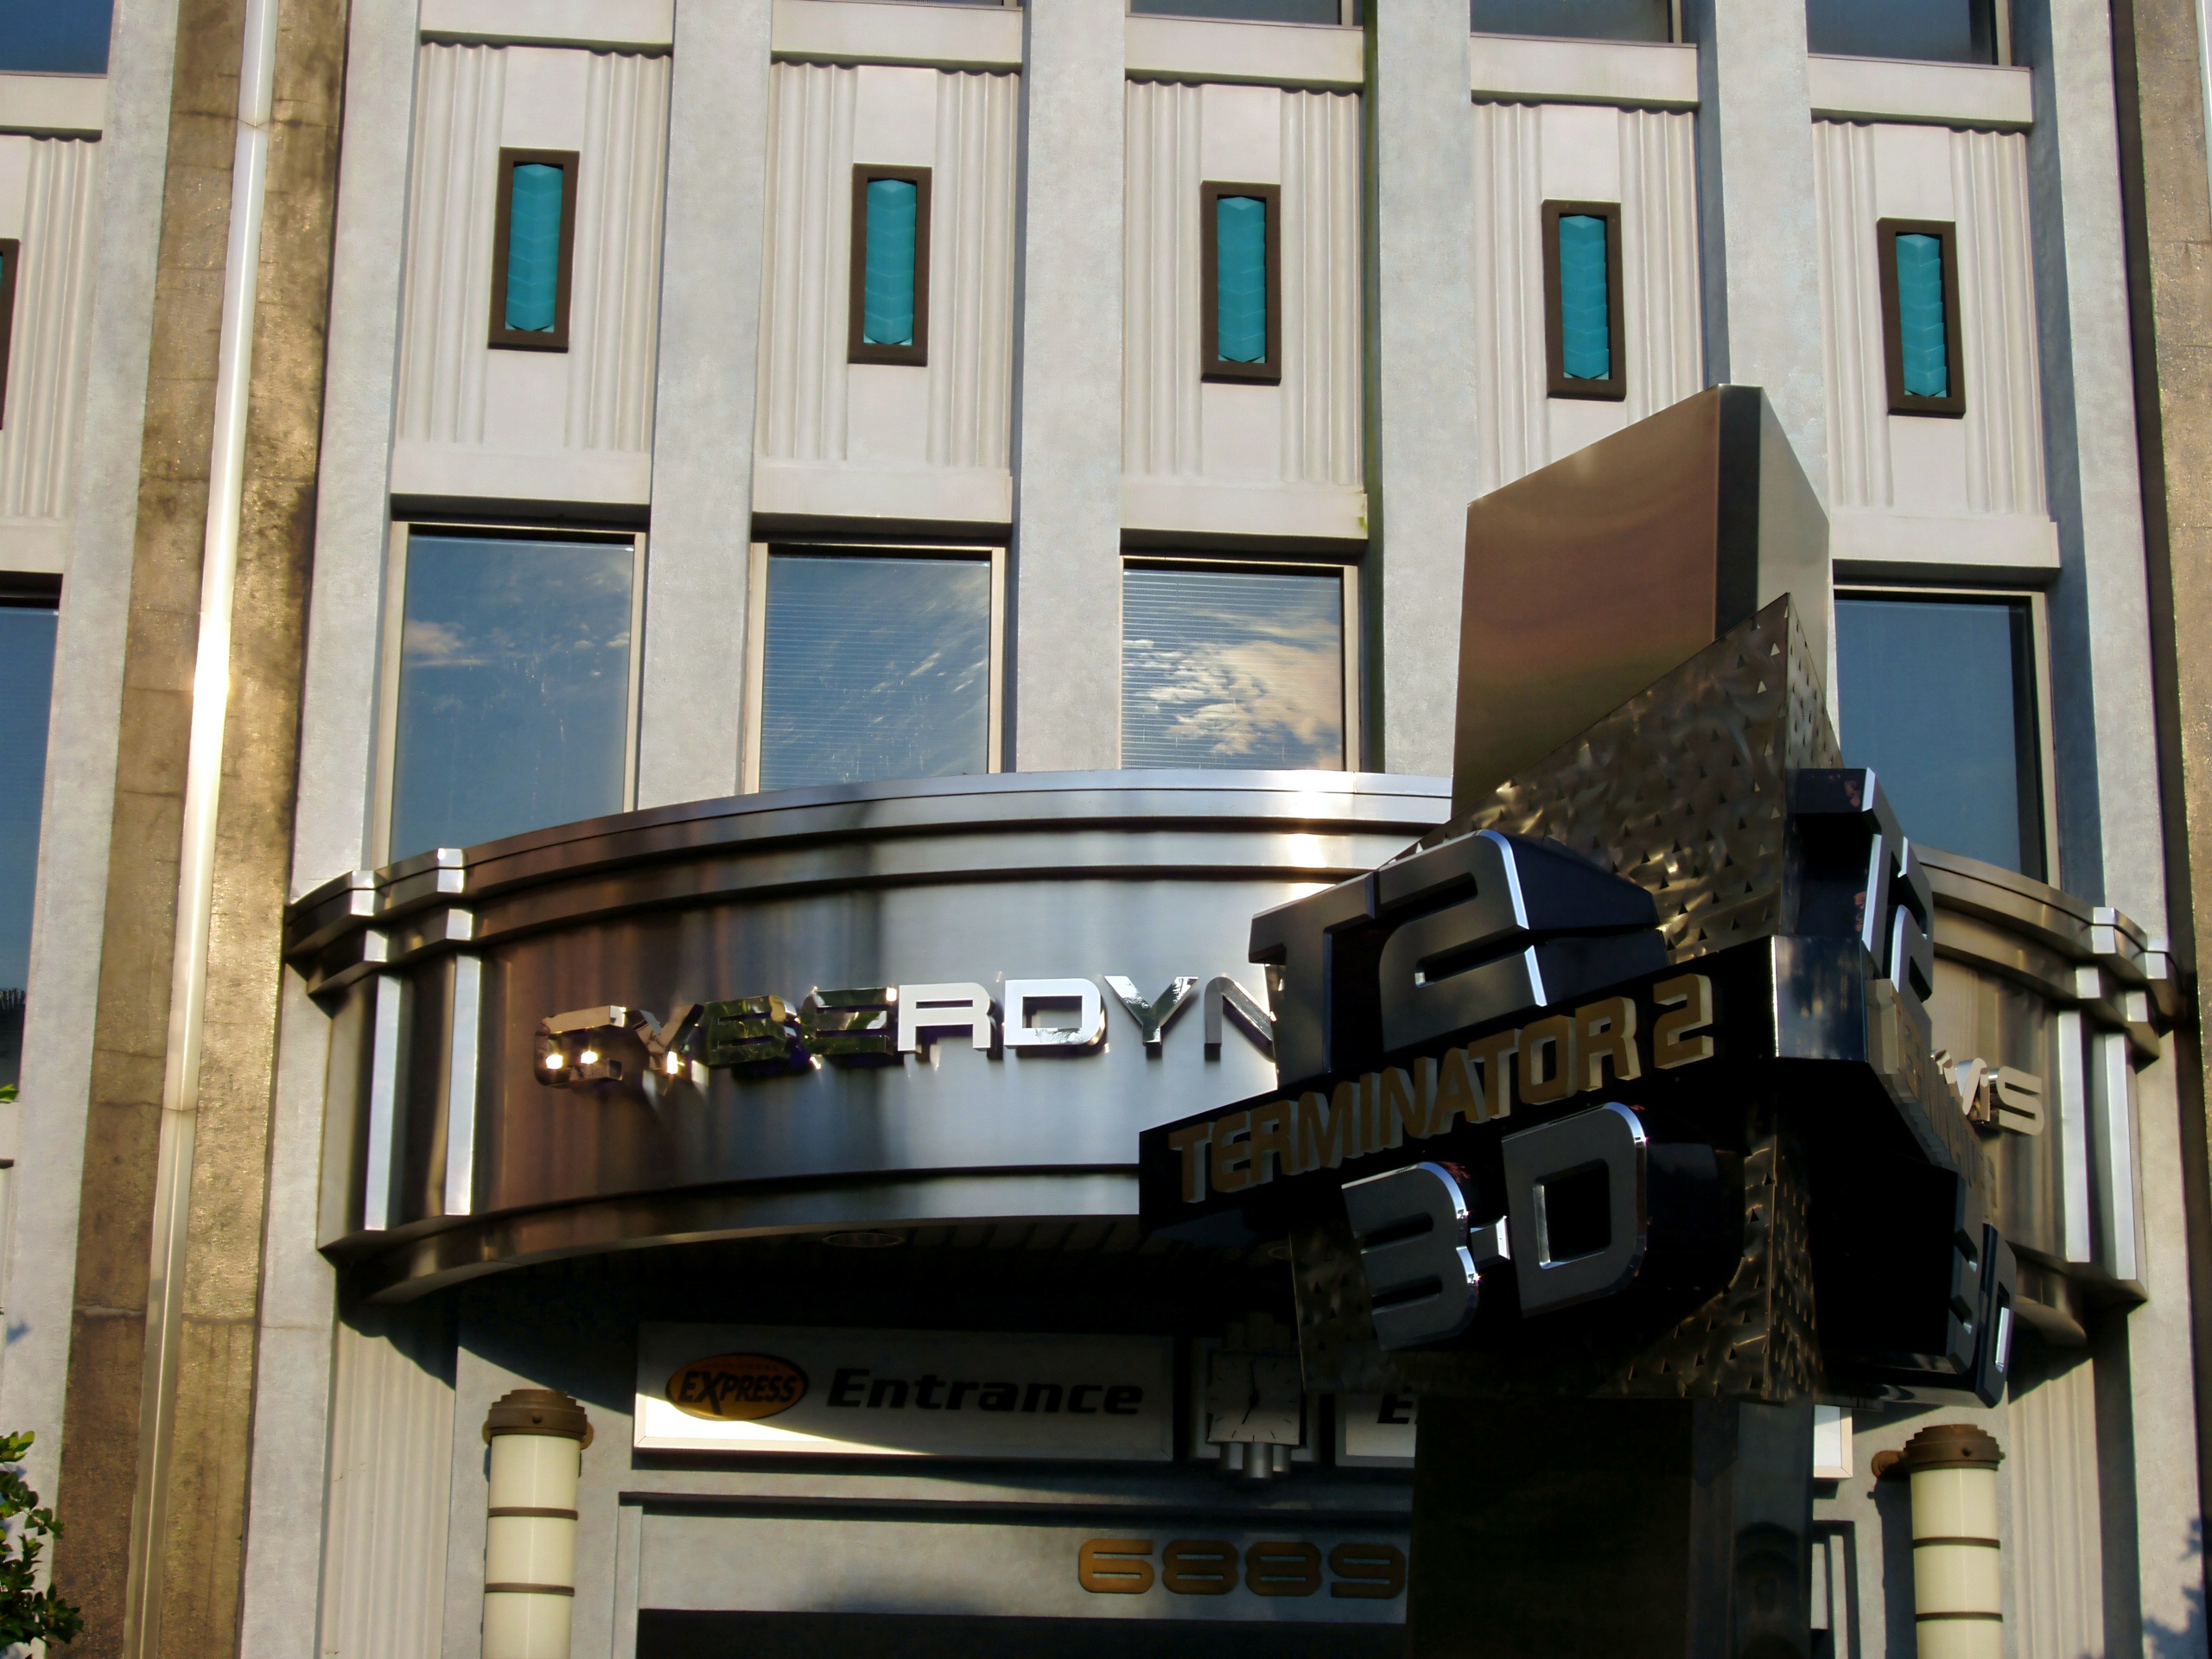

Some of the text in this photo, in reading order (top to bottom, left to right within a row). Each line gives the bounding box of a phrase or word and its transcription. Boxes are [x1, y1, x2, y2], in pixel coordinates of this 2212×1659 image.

[1249, 828, 1547, 1090] T2
[532, 976, 1274, 1087] CYBERDYN
[1168, 973, 1713, 1204] TERMINATOR 2
[1342, 1102, 1648, 1351] 3-D
[677, 1370, 798, 1415] EXPRESS
[827, 1368, 1143, 1414] Entrance
[1077, 1538, 1407, 1600] 6889
